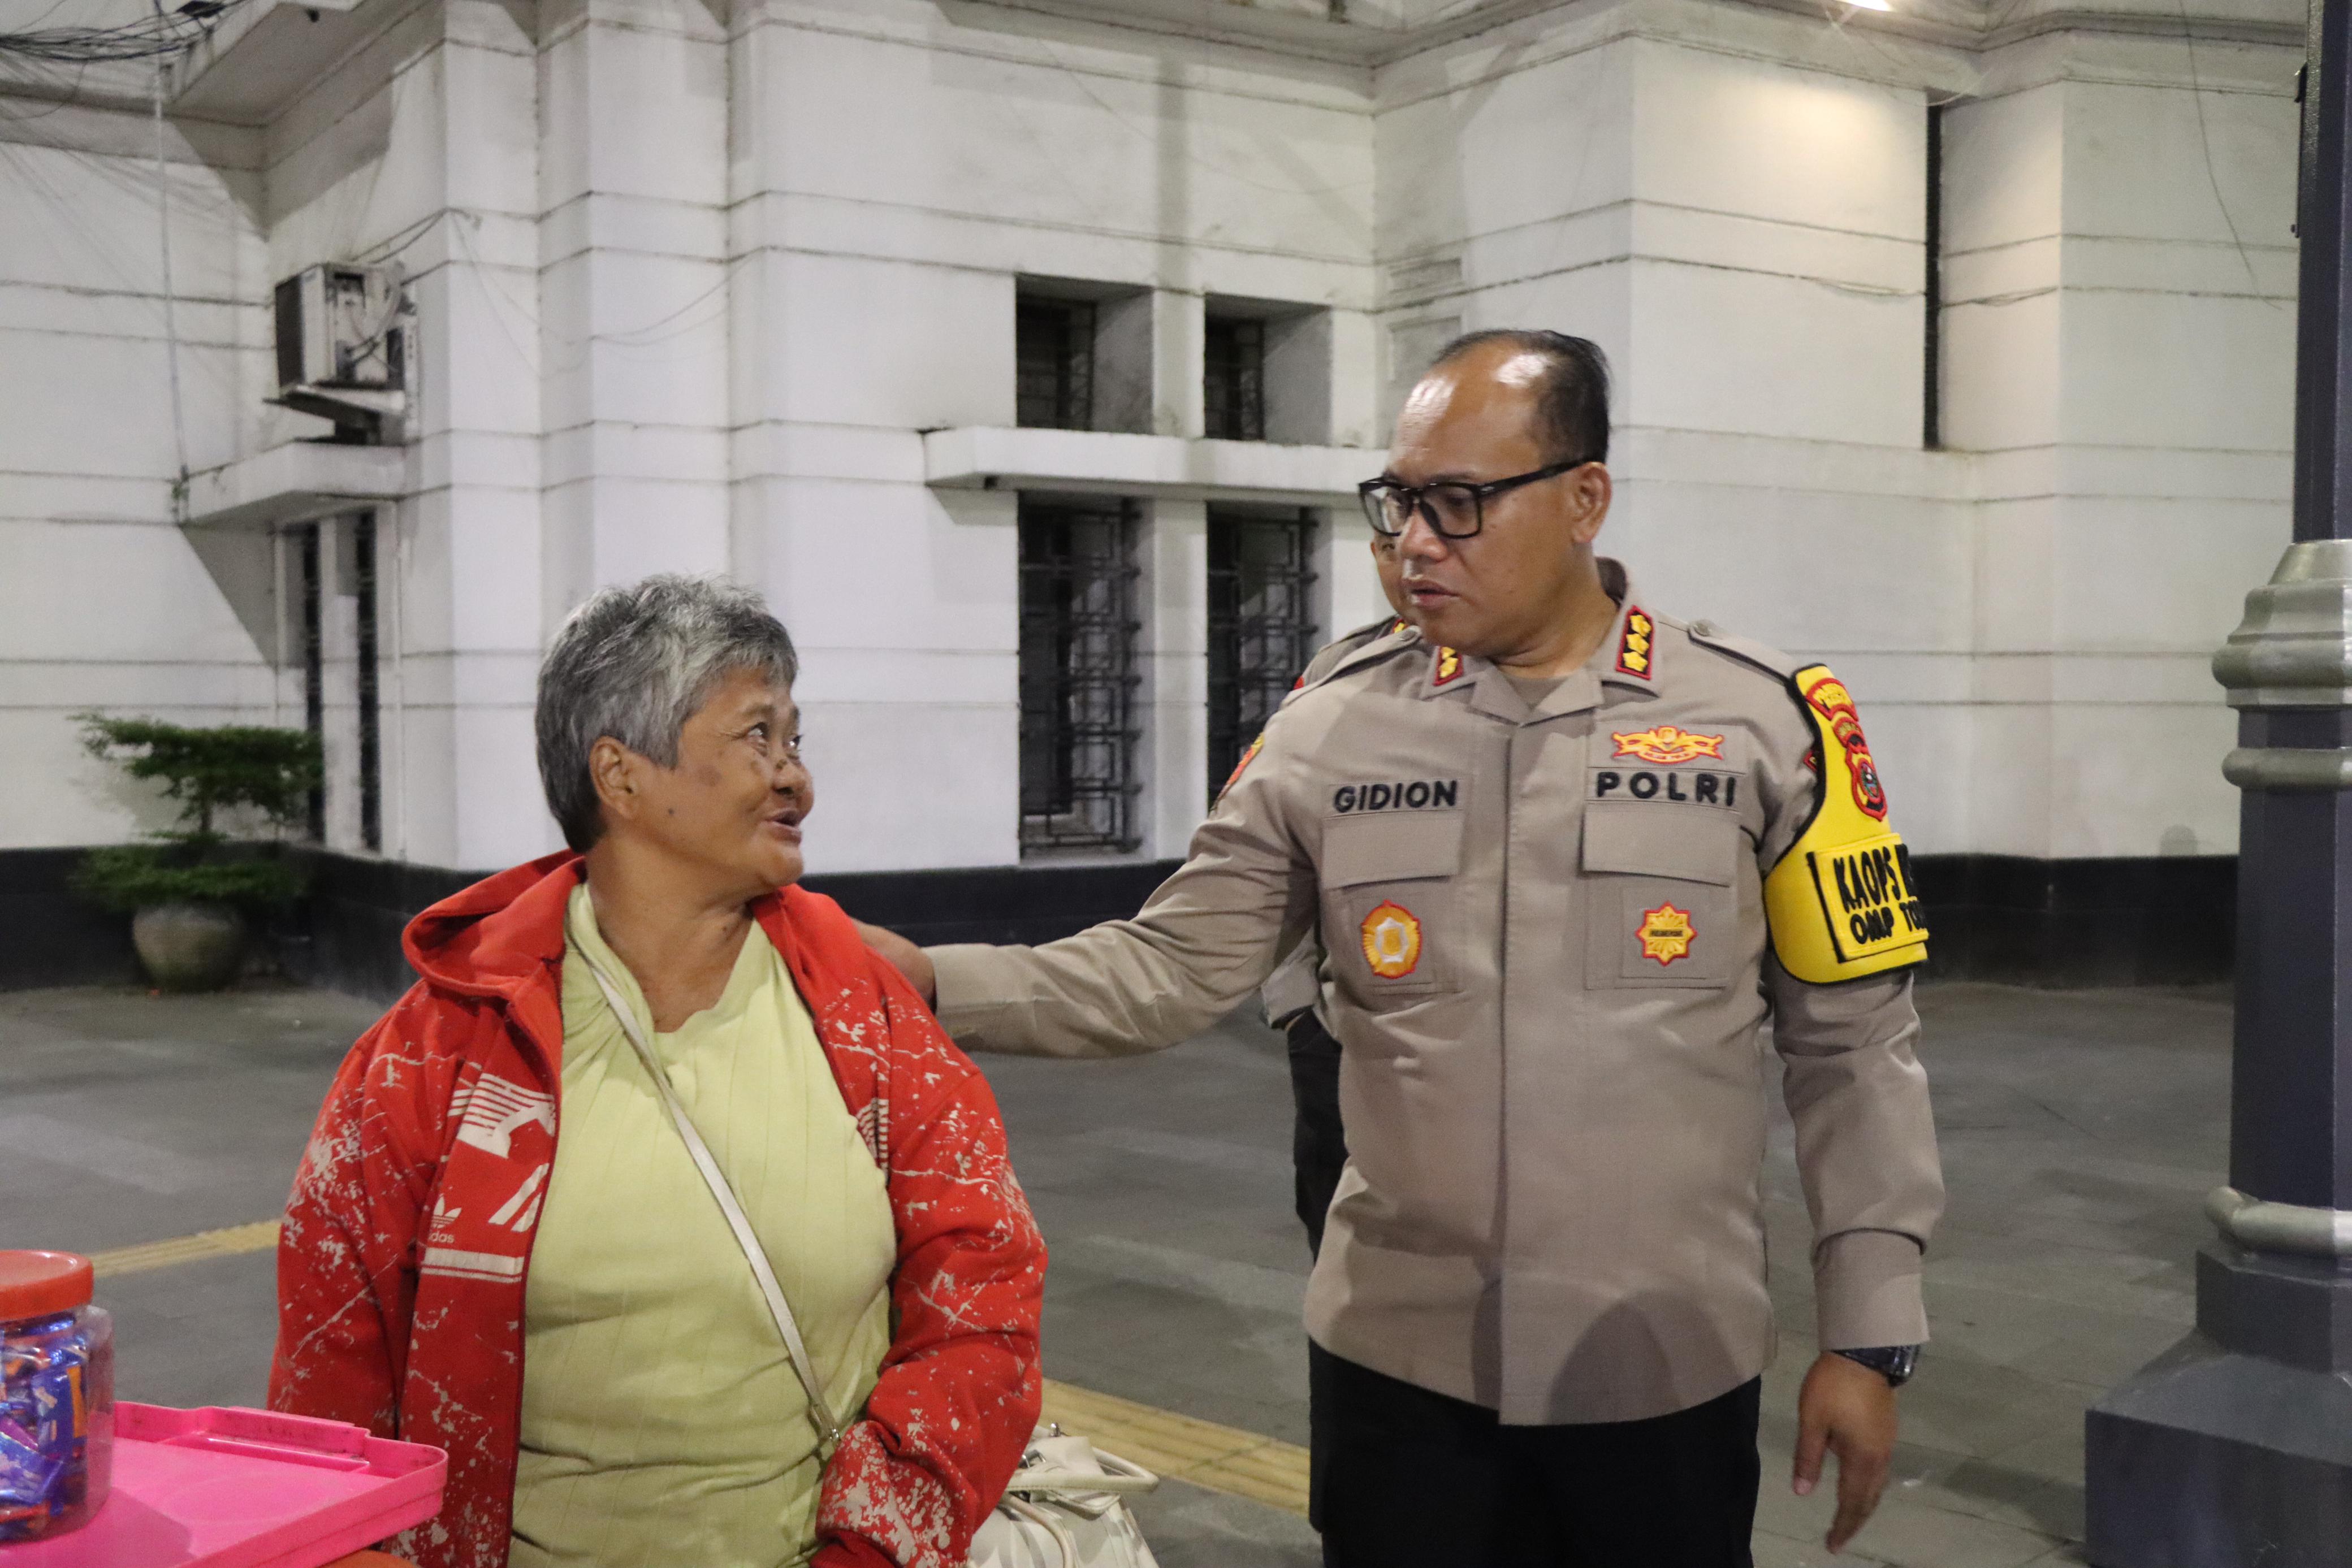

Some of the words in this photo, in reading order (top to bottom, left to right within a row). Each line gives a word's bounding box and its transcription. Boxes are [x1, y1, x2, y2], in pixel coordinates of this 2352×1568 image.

[1334, 780, 1458, 813] GIDION
[1597, 771, 1736, 807] POLRI
[1834, 846, 1901, 913] KAOPS
[1850, 907, 1895, 945] OMP
